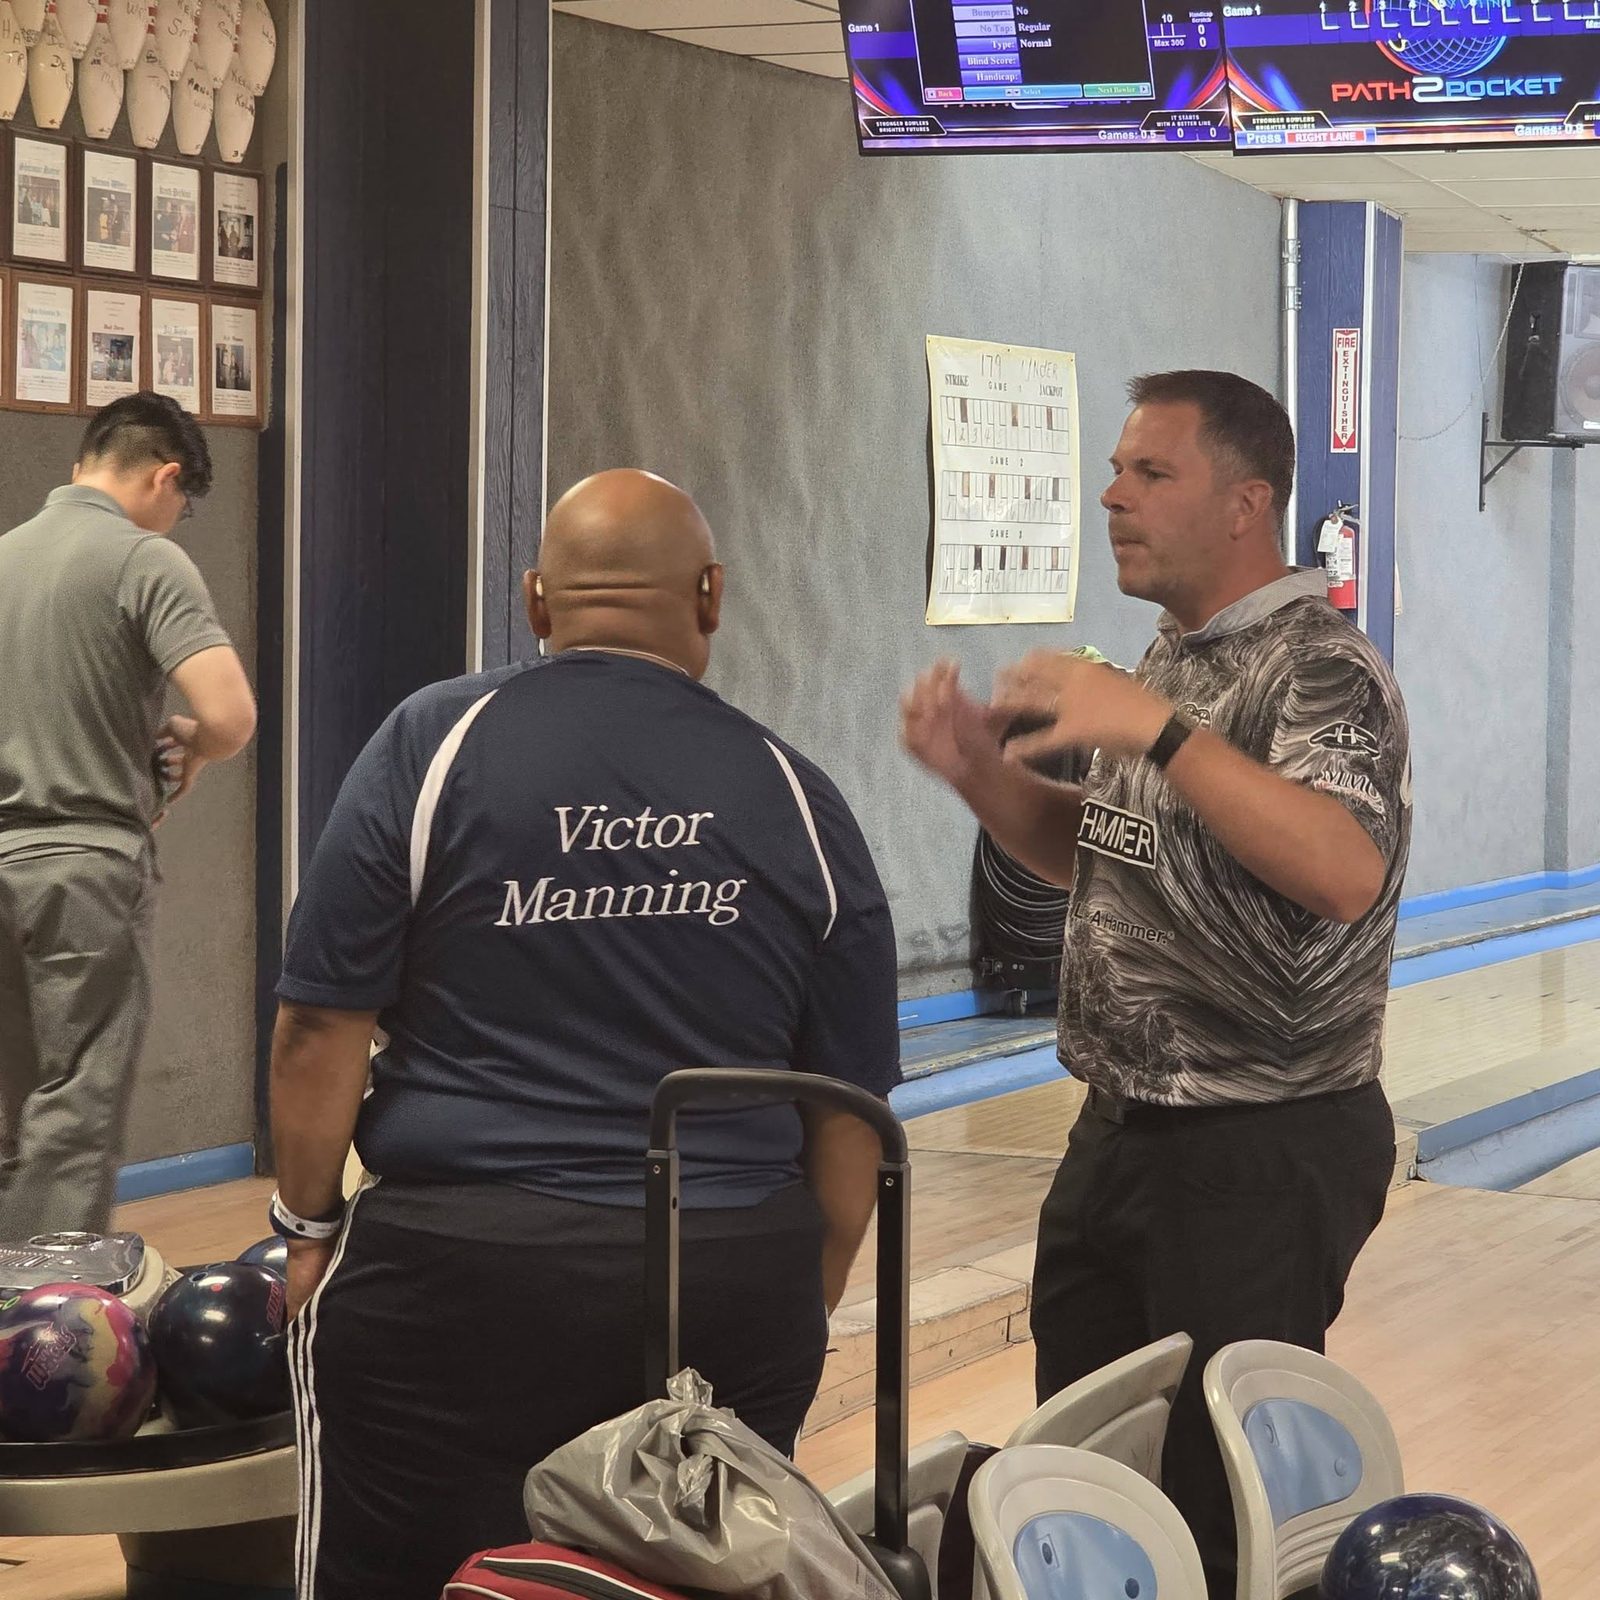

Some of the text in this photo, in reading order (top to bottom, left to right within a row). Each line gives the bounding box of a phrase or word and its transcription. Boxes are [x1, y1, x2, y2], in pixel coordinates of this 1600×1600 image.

[1016, 6, 1029, 16] No
[1223, 4, 1261, 17] Game 1
[1161, 13, 1173, 23] 10
[848, 23, 880, 33] Game 1
[980, 24, 992, 32] No
[1018, 22, 1051, 33] Regular
[1197, 24, 1205, 35] 0
[992, 38, 1052, 50] Type: Normal
[1154, 39, 1170, 47] Max
[1199, 36, 1207, 48] 0
[967, 55, 1016, 66] Blind Score:
[976, 71, 1018, 83] Handicap:
[1098, 130, 1156, 140] Games: 0.5
[1177, 128, 1217, 138] 0 0
[1514, 124, 1562, 136] Games:
[1247, 132, 1356, 144] Press RIGHT LANE
[1337, 337, 1356, 348] FIRE
[945, 374, 969, 387] STRIKE
[988, 381, 1007, 391] GAME
[1040, 384, 1063, 397] JACKPOT
[1341, 350, 1349, 439] EXTINGUISHER
[990, 456, 1009, 466] GAME
[990, 529, 1009, 538] GAME
[554, 804, 714, 853] Victor
[493, 869, 748, 926] Manning
[1090, 910, 1101, 926] A
